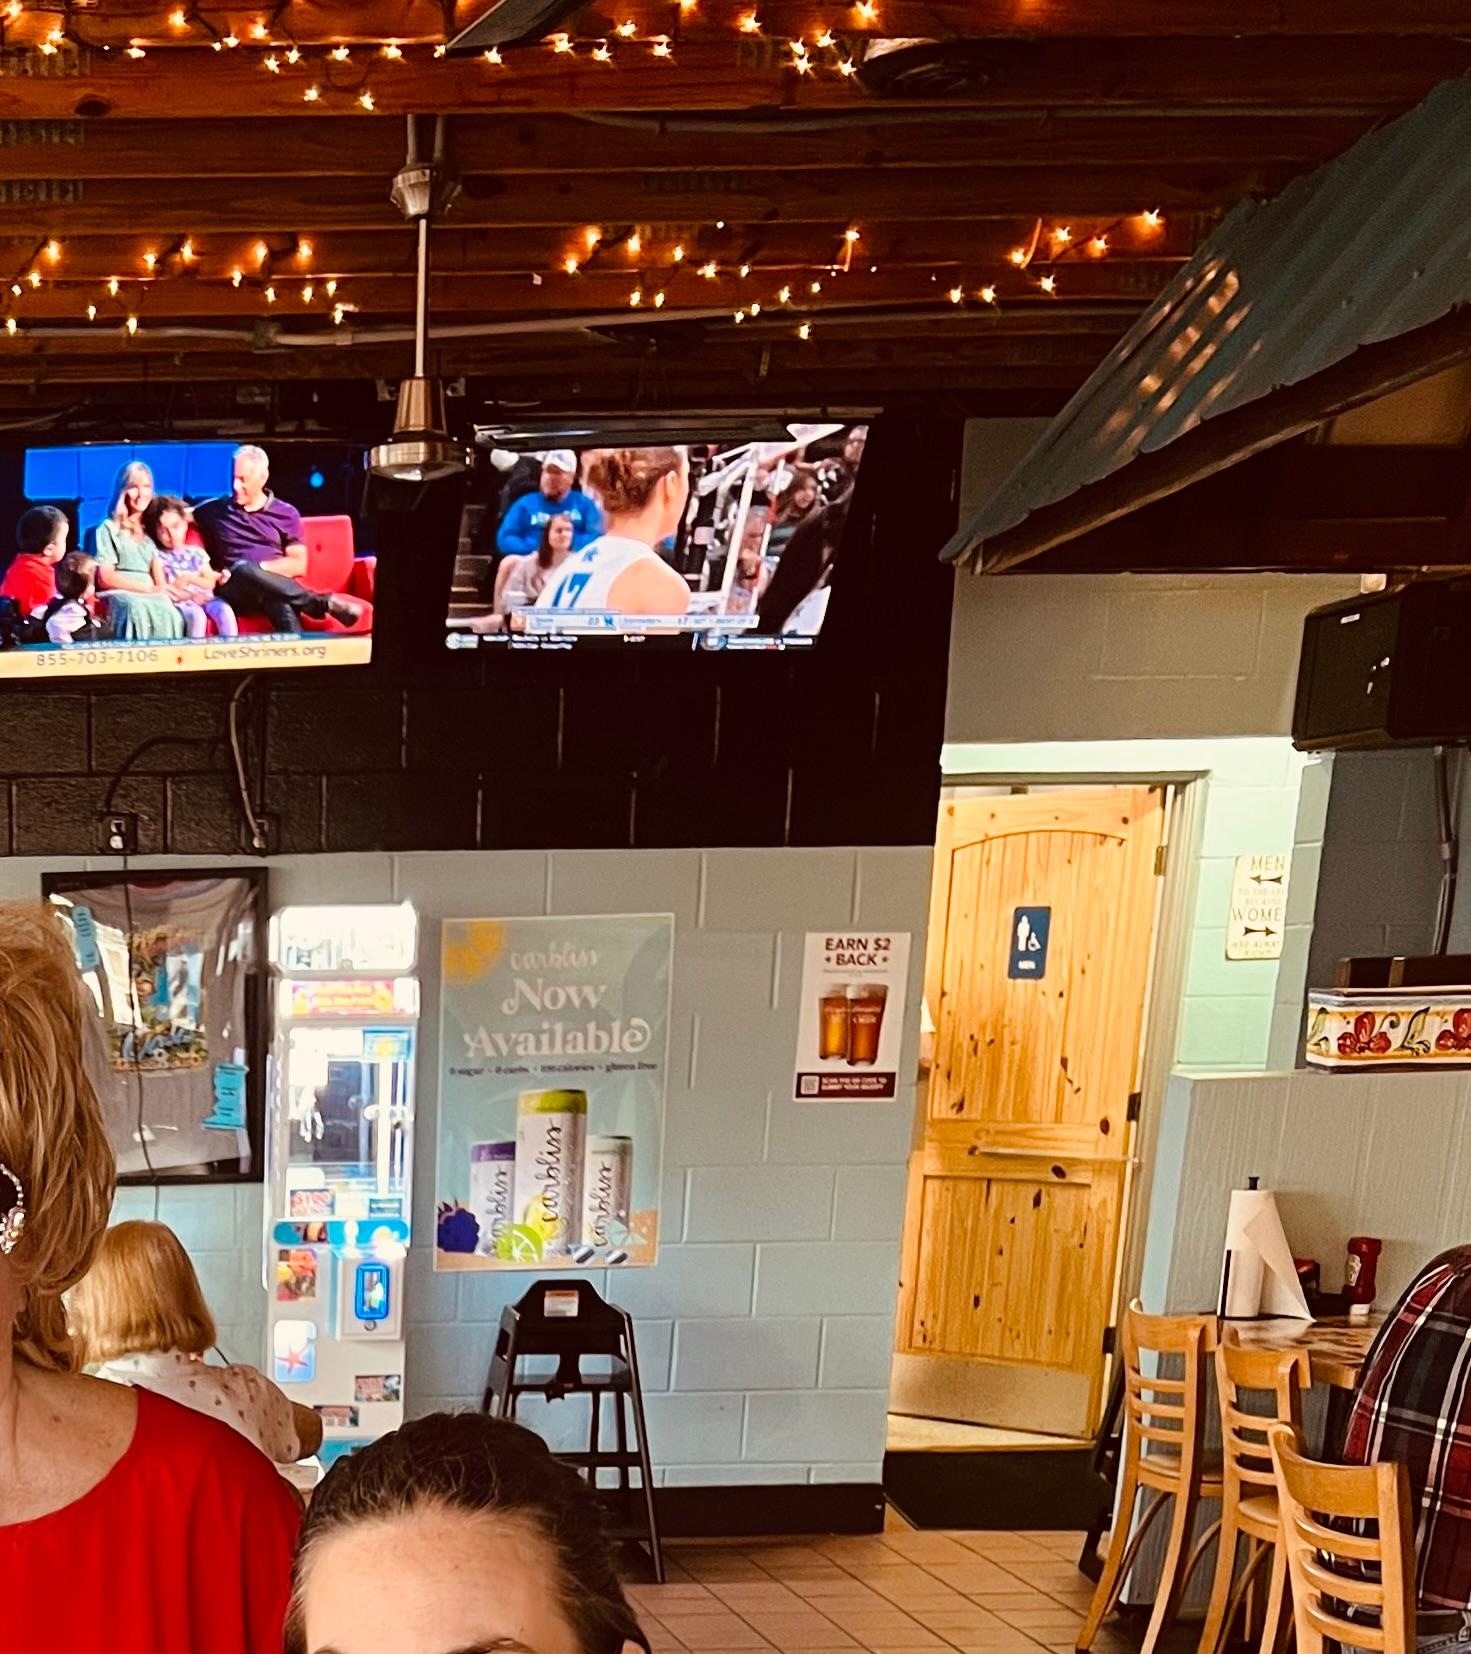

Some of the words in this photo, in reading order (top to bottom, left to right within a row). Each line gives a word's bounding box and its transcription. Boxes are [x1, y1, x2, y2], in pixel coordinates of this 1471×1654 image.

[36, 649, 158, 667] 855-703-7106
[204, 645, 326, 660] LoveShriners.org
[1251, 855, 1285, 871] MEN
[1232, 908, 1282, 922] WOME
[825, 938, 868, 951] EARN
[874, 938, 891, 951] $2
[836, 953, 878, 966] BACK
[500, 977, 607, 1015] Now
[462, 1017, 651, 1058] Available
